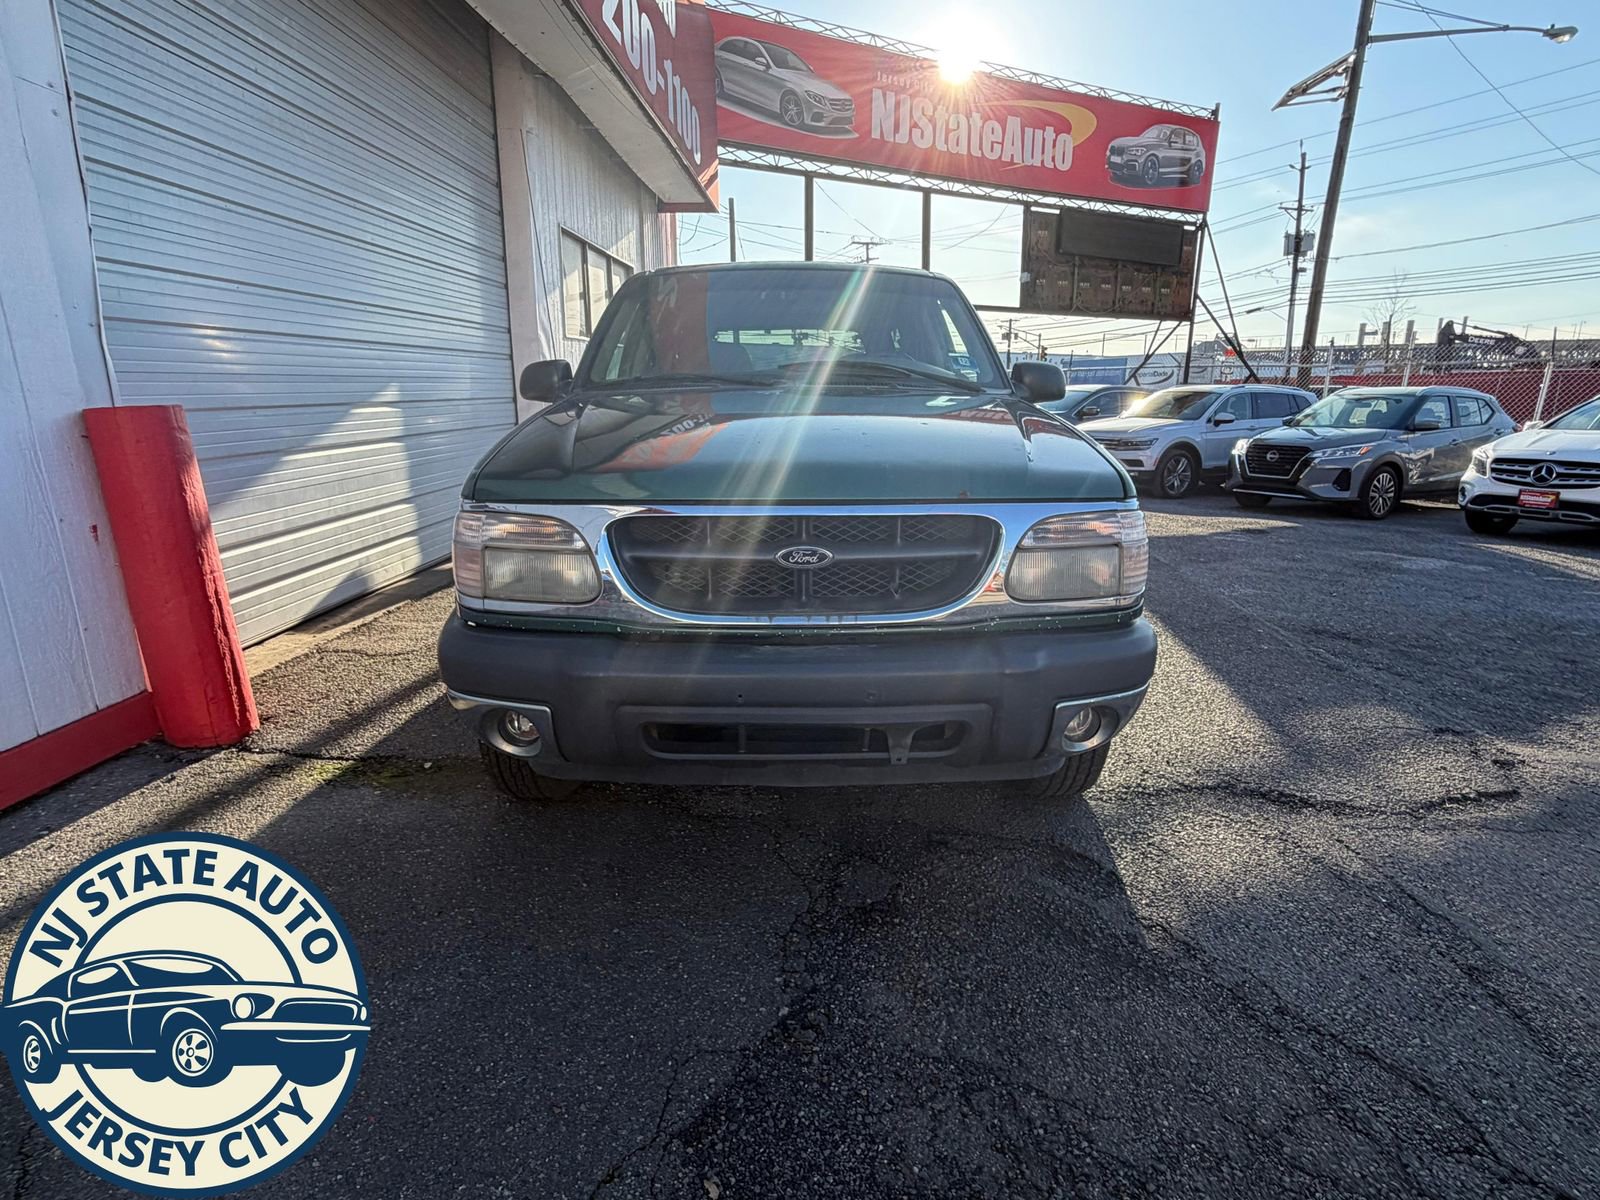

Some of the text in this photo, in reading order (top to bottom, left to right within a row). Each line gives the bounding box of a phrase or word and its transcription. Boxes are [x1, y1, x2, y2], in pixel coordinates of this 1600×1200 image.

[871, 88, 1073, 172] NJStateAuto
[1468, 336, 1496, 345] DEERE
[789, 551, 819, 563] Ford
